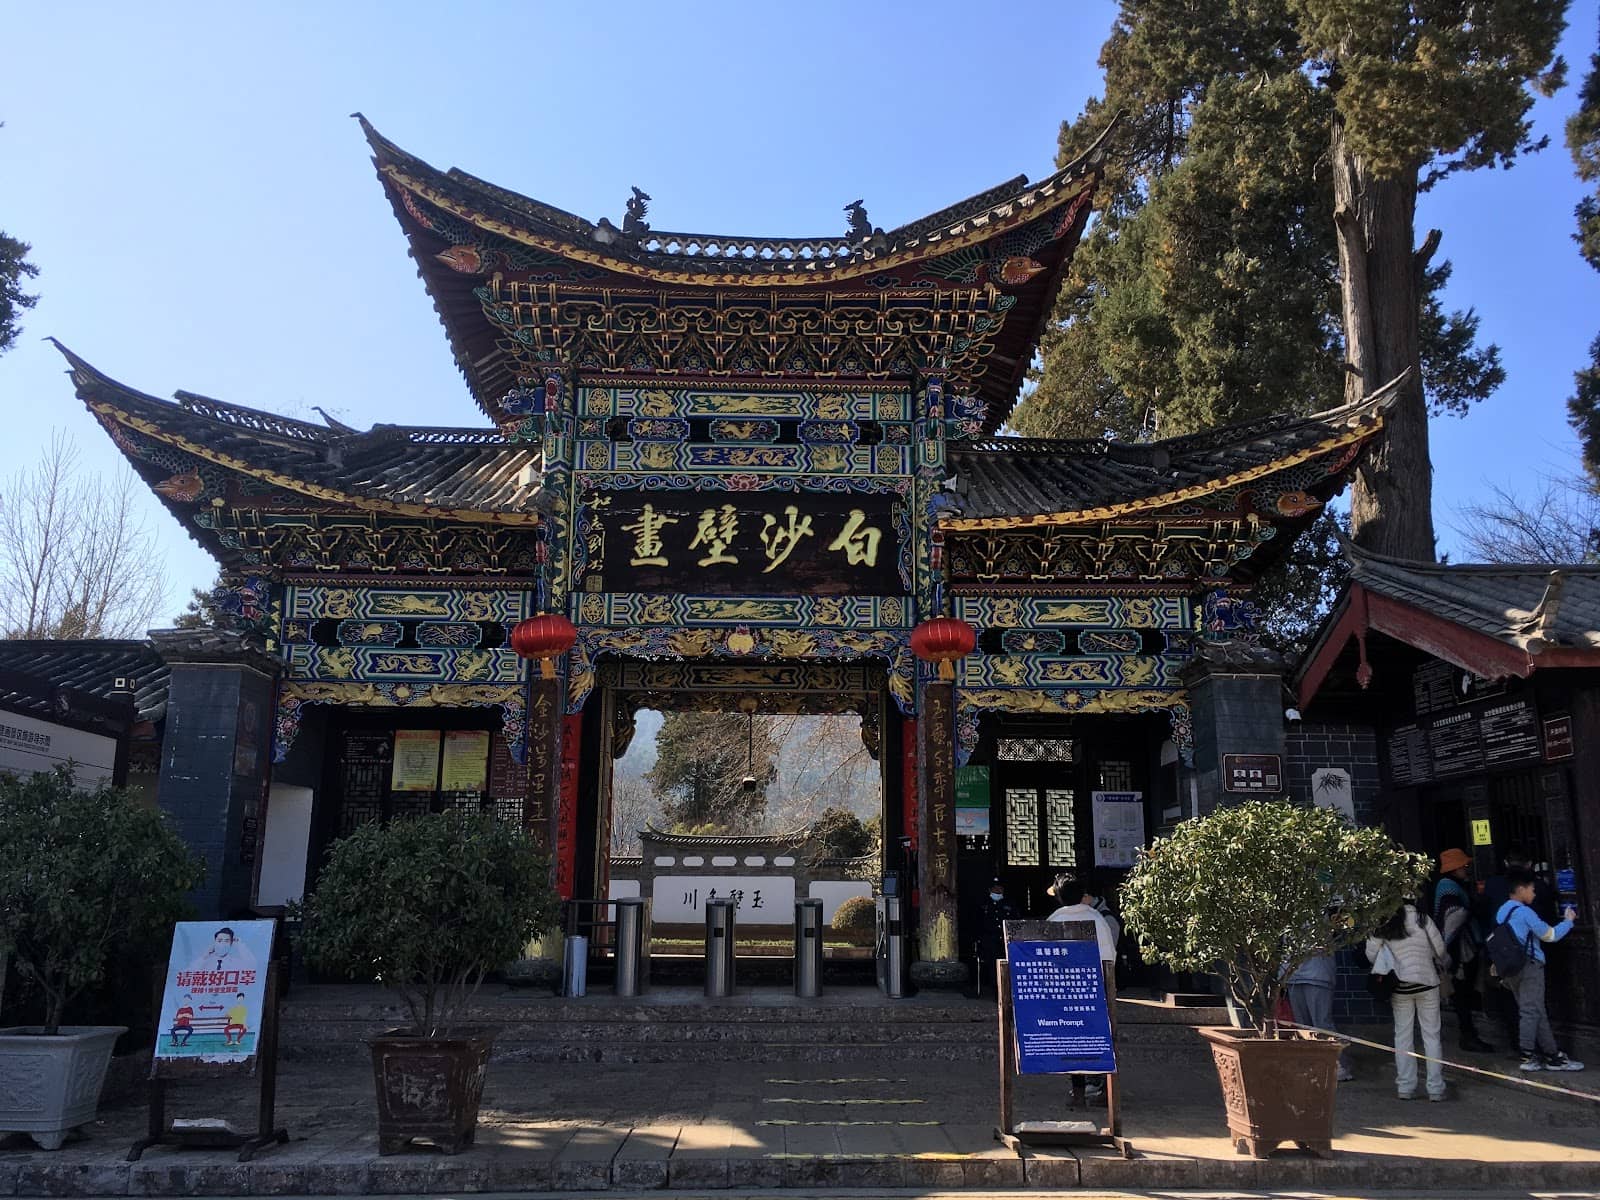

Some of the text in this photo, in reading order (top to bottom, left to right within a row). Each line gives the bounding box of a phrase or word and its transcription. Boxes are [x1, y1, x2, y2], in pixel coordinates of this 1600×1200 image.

[176, 970, 256, 987] 请戴好口罩
[1059, 1019, 1085, 1028] Prompt
